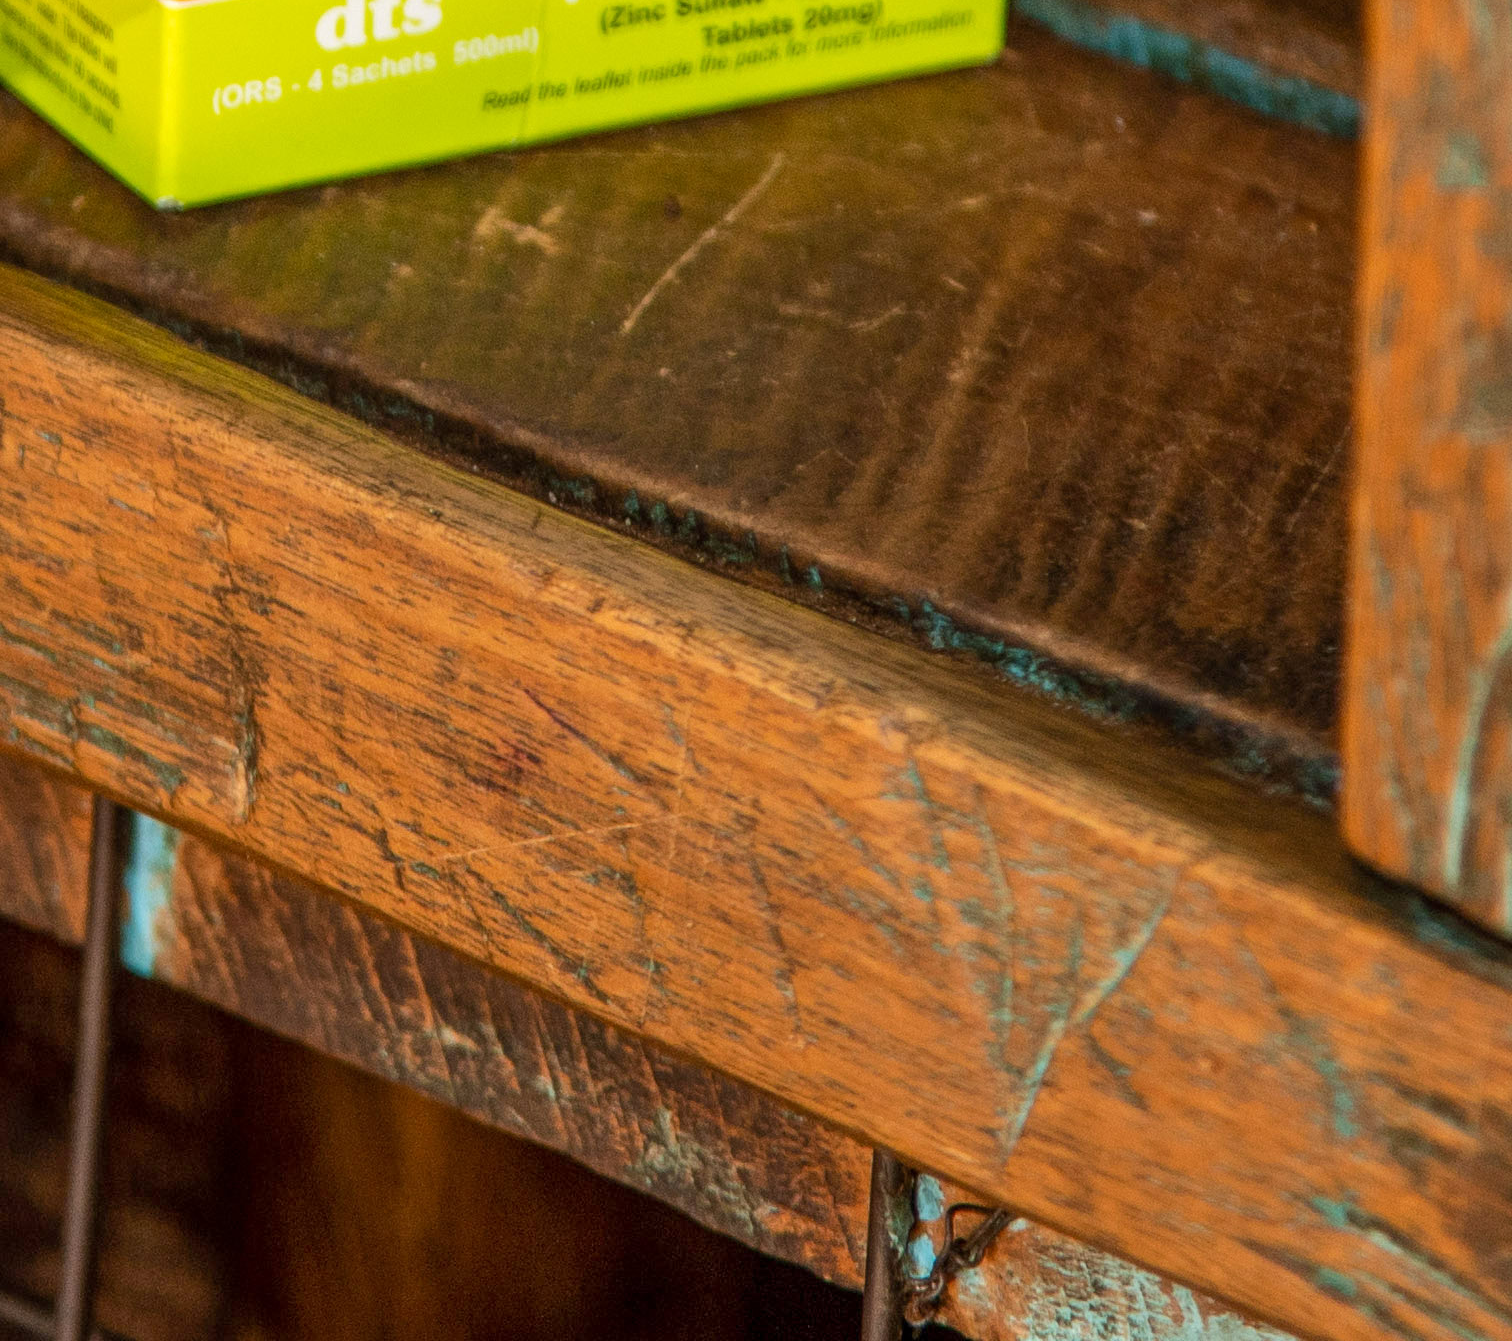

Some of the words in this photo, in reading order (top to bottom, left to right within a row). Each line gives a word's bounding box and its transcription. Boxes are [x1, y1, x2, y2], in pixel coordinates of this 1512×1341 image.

[600, 2, 666, 36] (Zinc
[702, 15, 794, 48] Tablets
[212, 76, 282, 115] (ORS
[308, 68, 323, 93] 4
[332, 51, 437, 90] Sachets
[453, 27, 539, 65] 500ml)
[481, 84, 531, 112] Read
[538, 80, 567, 102] the
